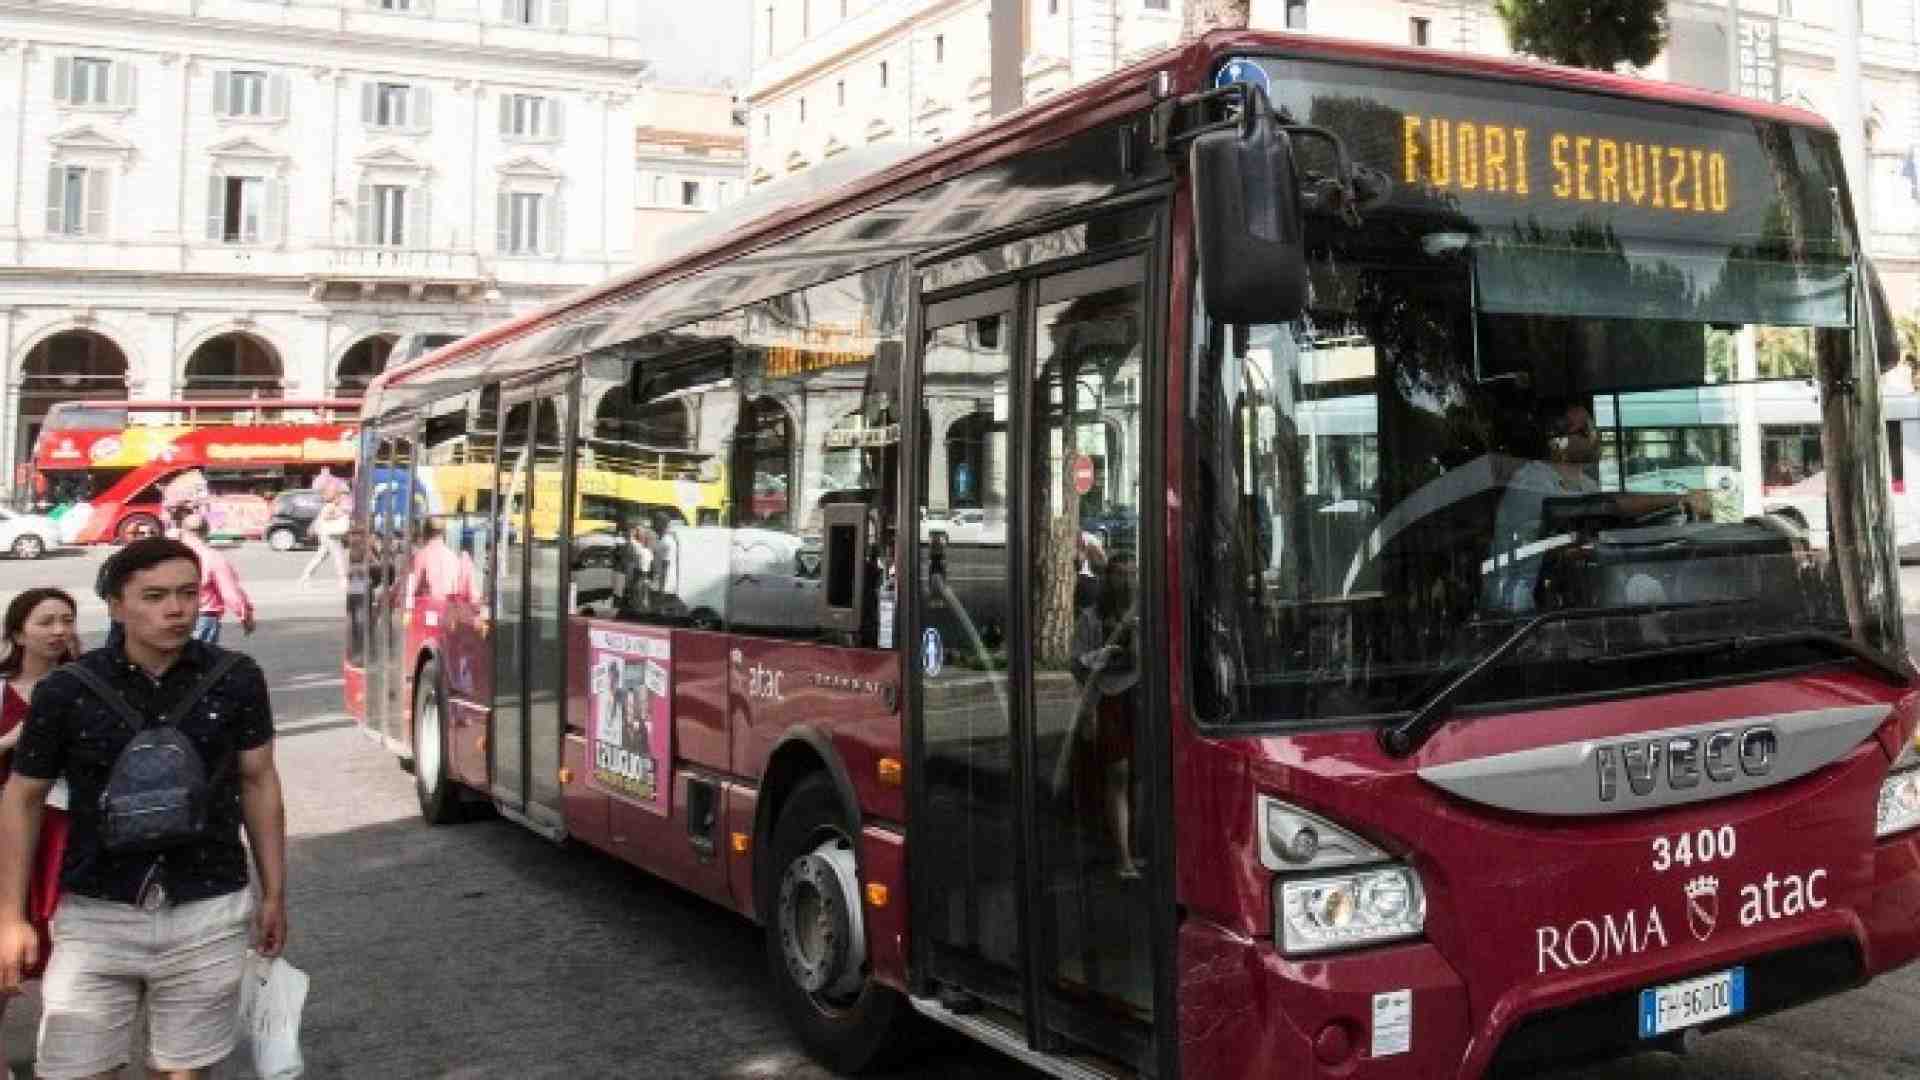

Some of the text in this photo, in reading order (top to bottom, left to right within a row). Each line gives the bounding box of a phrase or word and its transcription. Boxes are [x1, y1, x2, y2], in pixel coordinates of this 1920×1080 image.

[1402, 114, 1728, 212] FUORI SERVIZIO
[748, 662, 785, 701] atac
[1595, 725, 1777, 802] IVECO
[1652, 824, 1737, 872] 3400
[1535, 868, 1828, 974] ROMA atac
